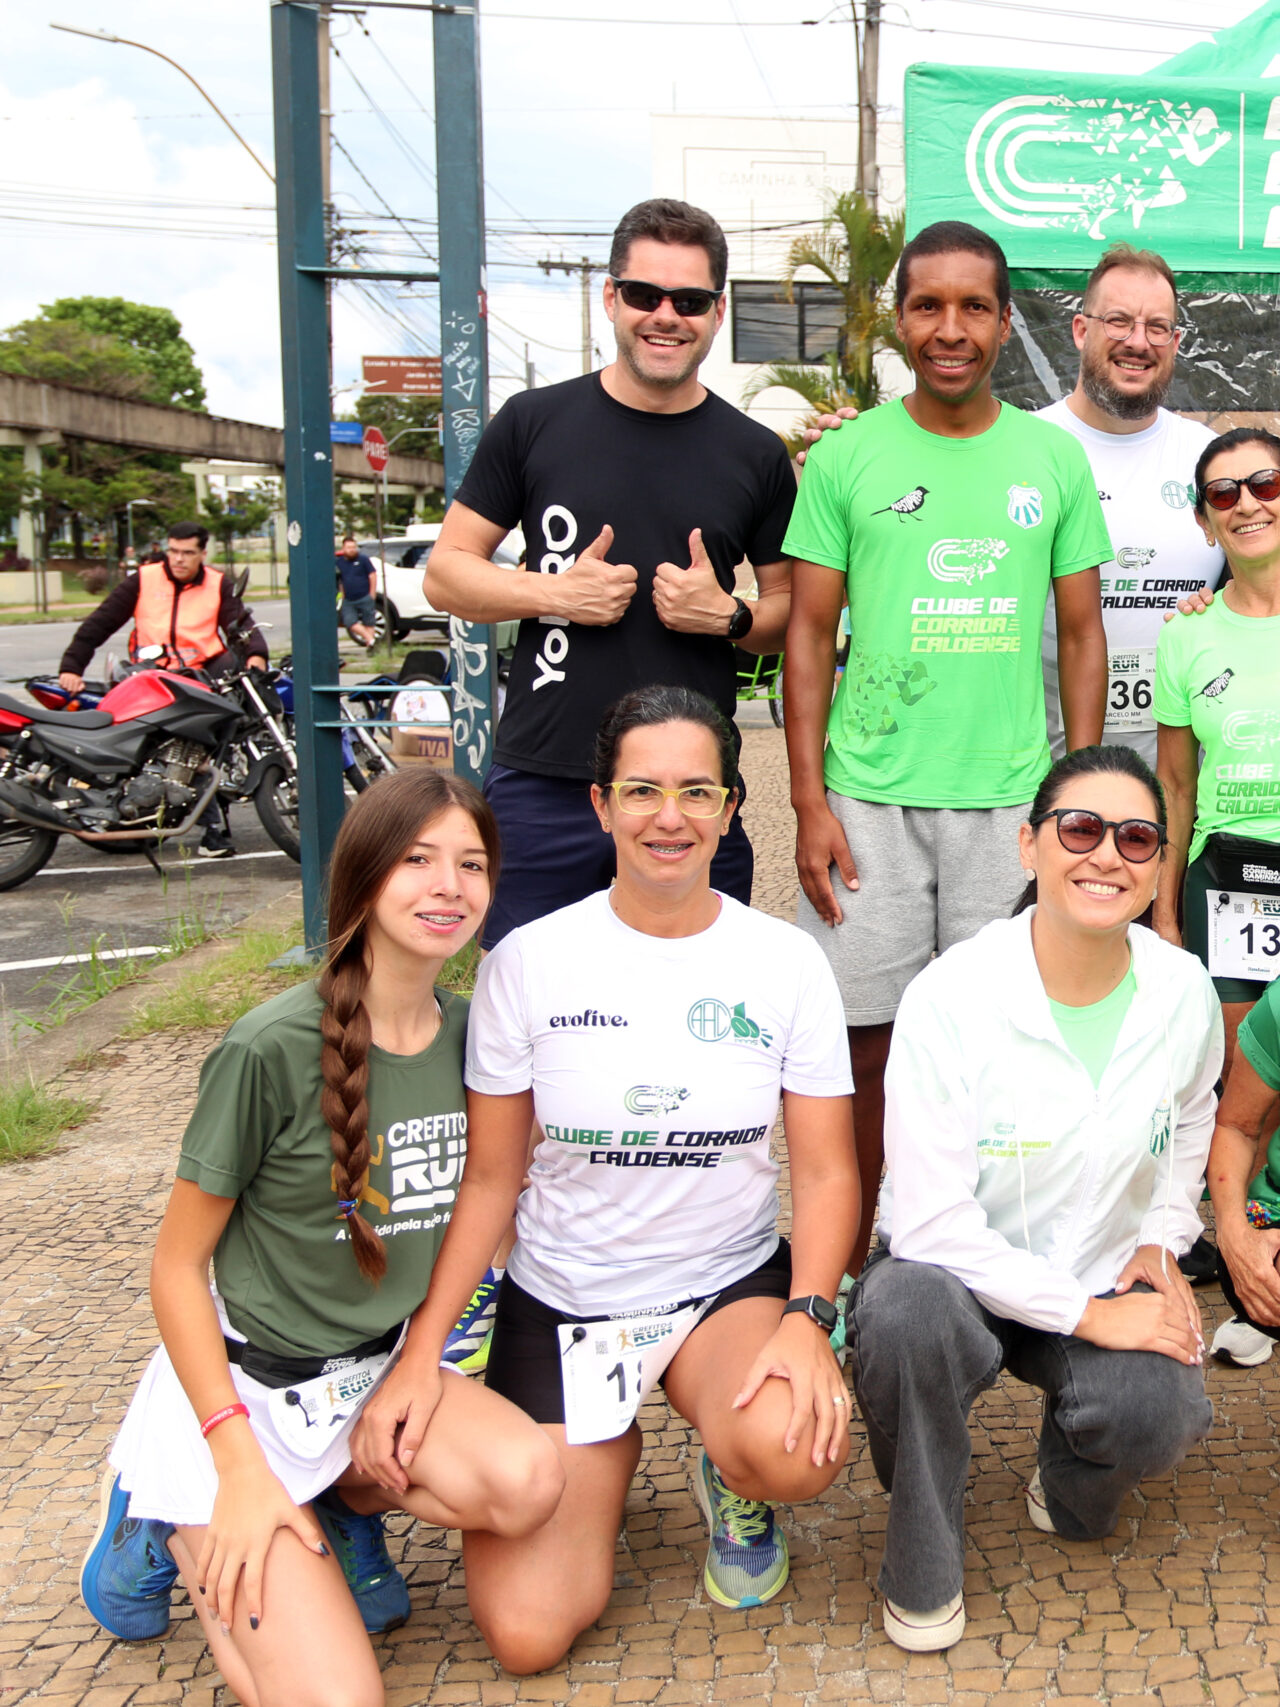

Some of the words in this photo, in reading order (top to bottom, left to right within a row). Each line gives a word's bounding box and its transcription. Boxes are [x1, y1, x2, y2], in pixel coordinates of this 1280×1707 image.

[364, 441, 388, 460] PARE
[1114, 579, 1138, 591] DE
[533, 504, 578, 692] YoRO
[911, 598, 984, 614] CLUBE
[989, 598, 1018, 614] DE
[1101, 596, 1178, 608] ALDENSE
[911, 618, 1007, 634] CORRIDA
[910, 637, 1021, 653] CALDENSE
[1110, 679, 1152, 710] 36
[418, 740, 447, 758] IVA
[1215, 763, 1273, 780] CLUBE
[388, 1111, 467, 1147] CREFITO
[545, 1124, 613, 1146] CLUBE
[621, 1131, 659, 1146] DE
[665, 1125, 768, 1147] CORRIDA
[590, 1151, 722, 1168] CALDENSE
[335, 1229, 346, 1240] A
[393, 1218, 421, 1235] pela
[633, 1327, 673, 1342] RUN
